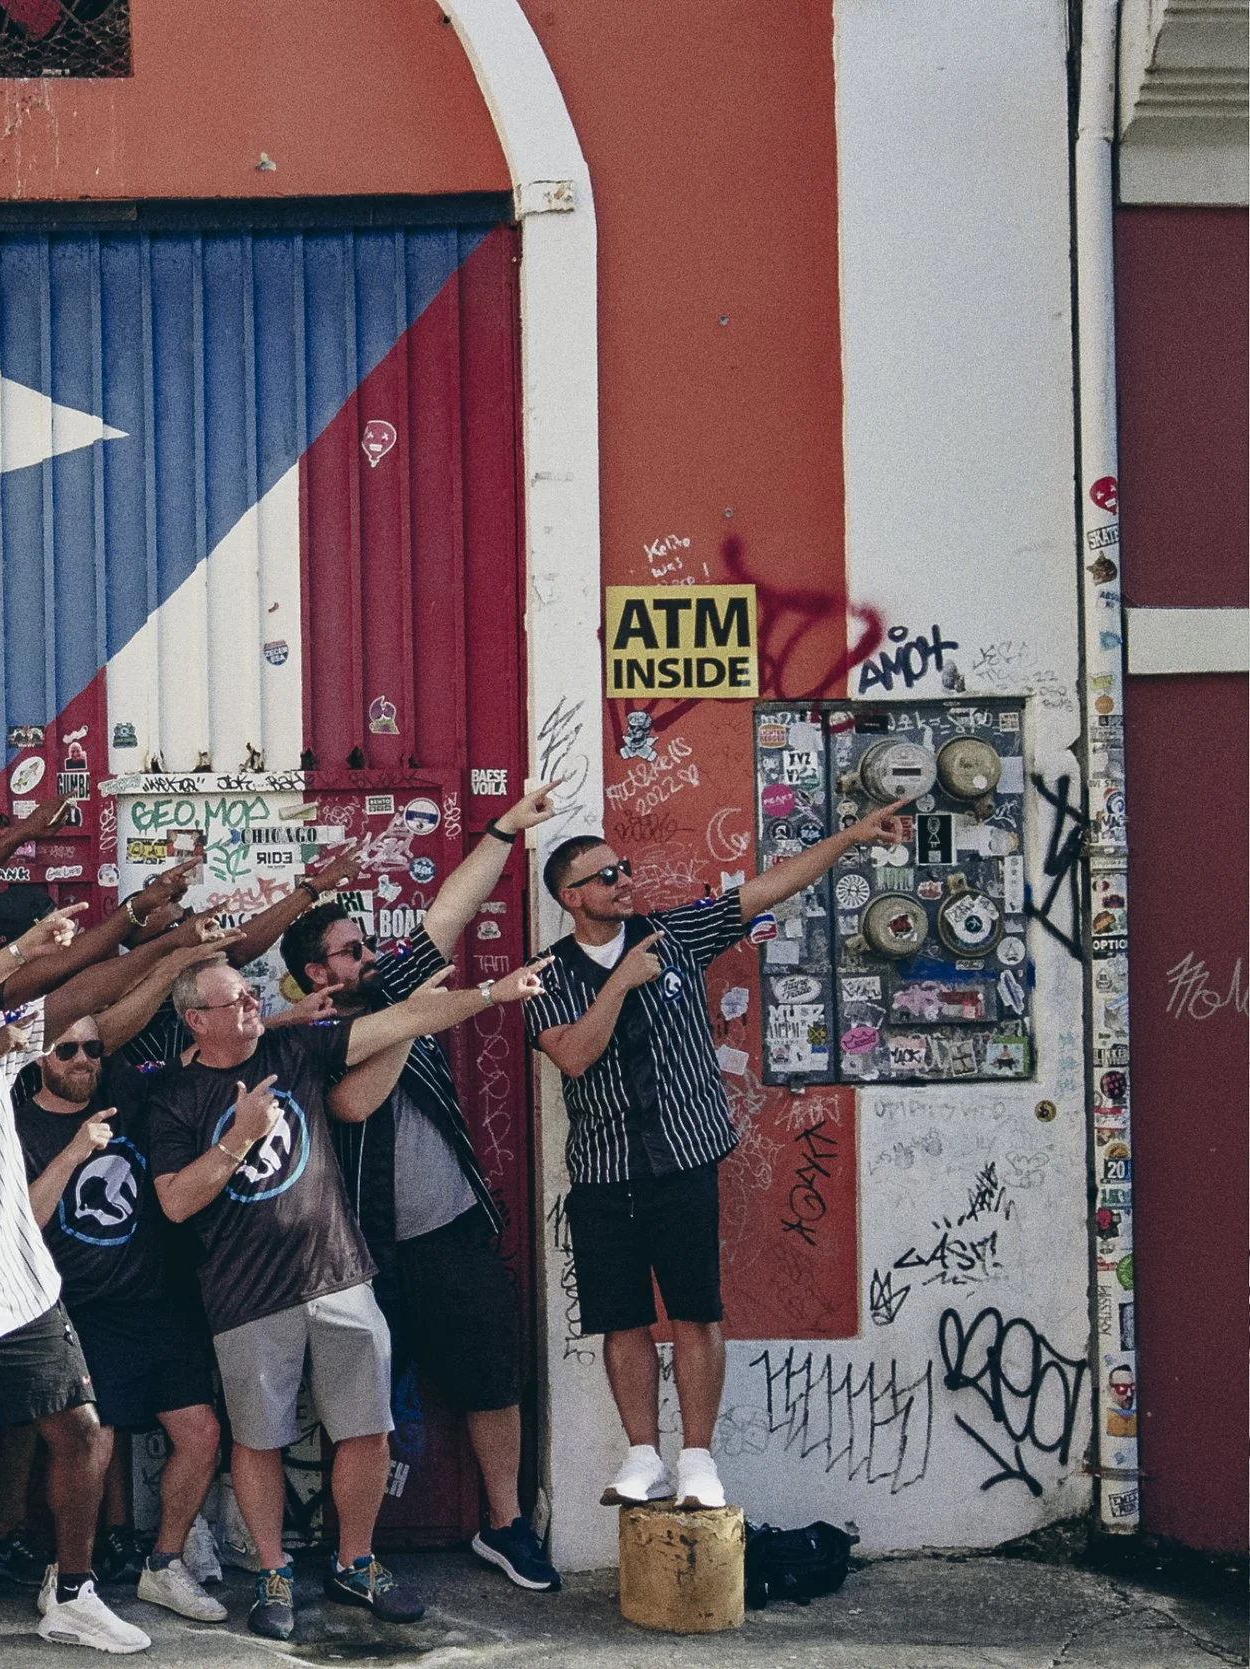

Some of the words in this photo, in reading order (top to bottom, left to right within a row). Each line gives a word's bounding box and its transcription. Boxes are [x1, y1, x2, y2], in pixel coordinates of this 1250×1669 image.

[613, 597, 750, 649] ATM
[614, 657, 750, 689] INSIDE
[471, 769, 507, 782] BAESE
[471, 782, 507, 795] VOILA
[636, 776, 684, 816] 2022
[241, 827, 318, 844] CHICAGO
[1107, 1161, 1125, 1179] 20
